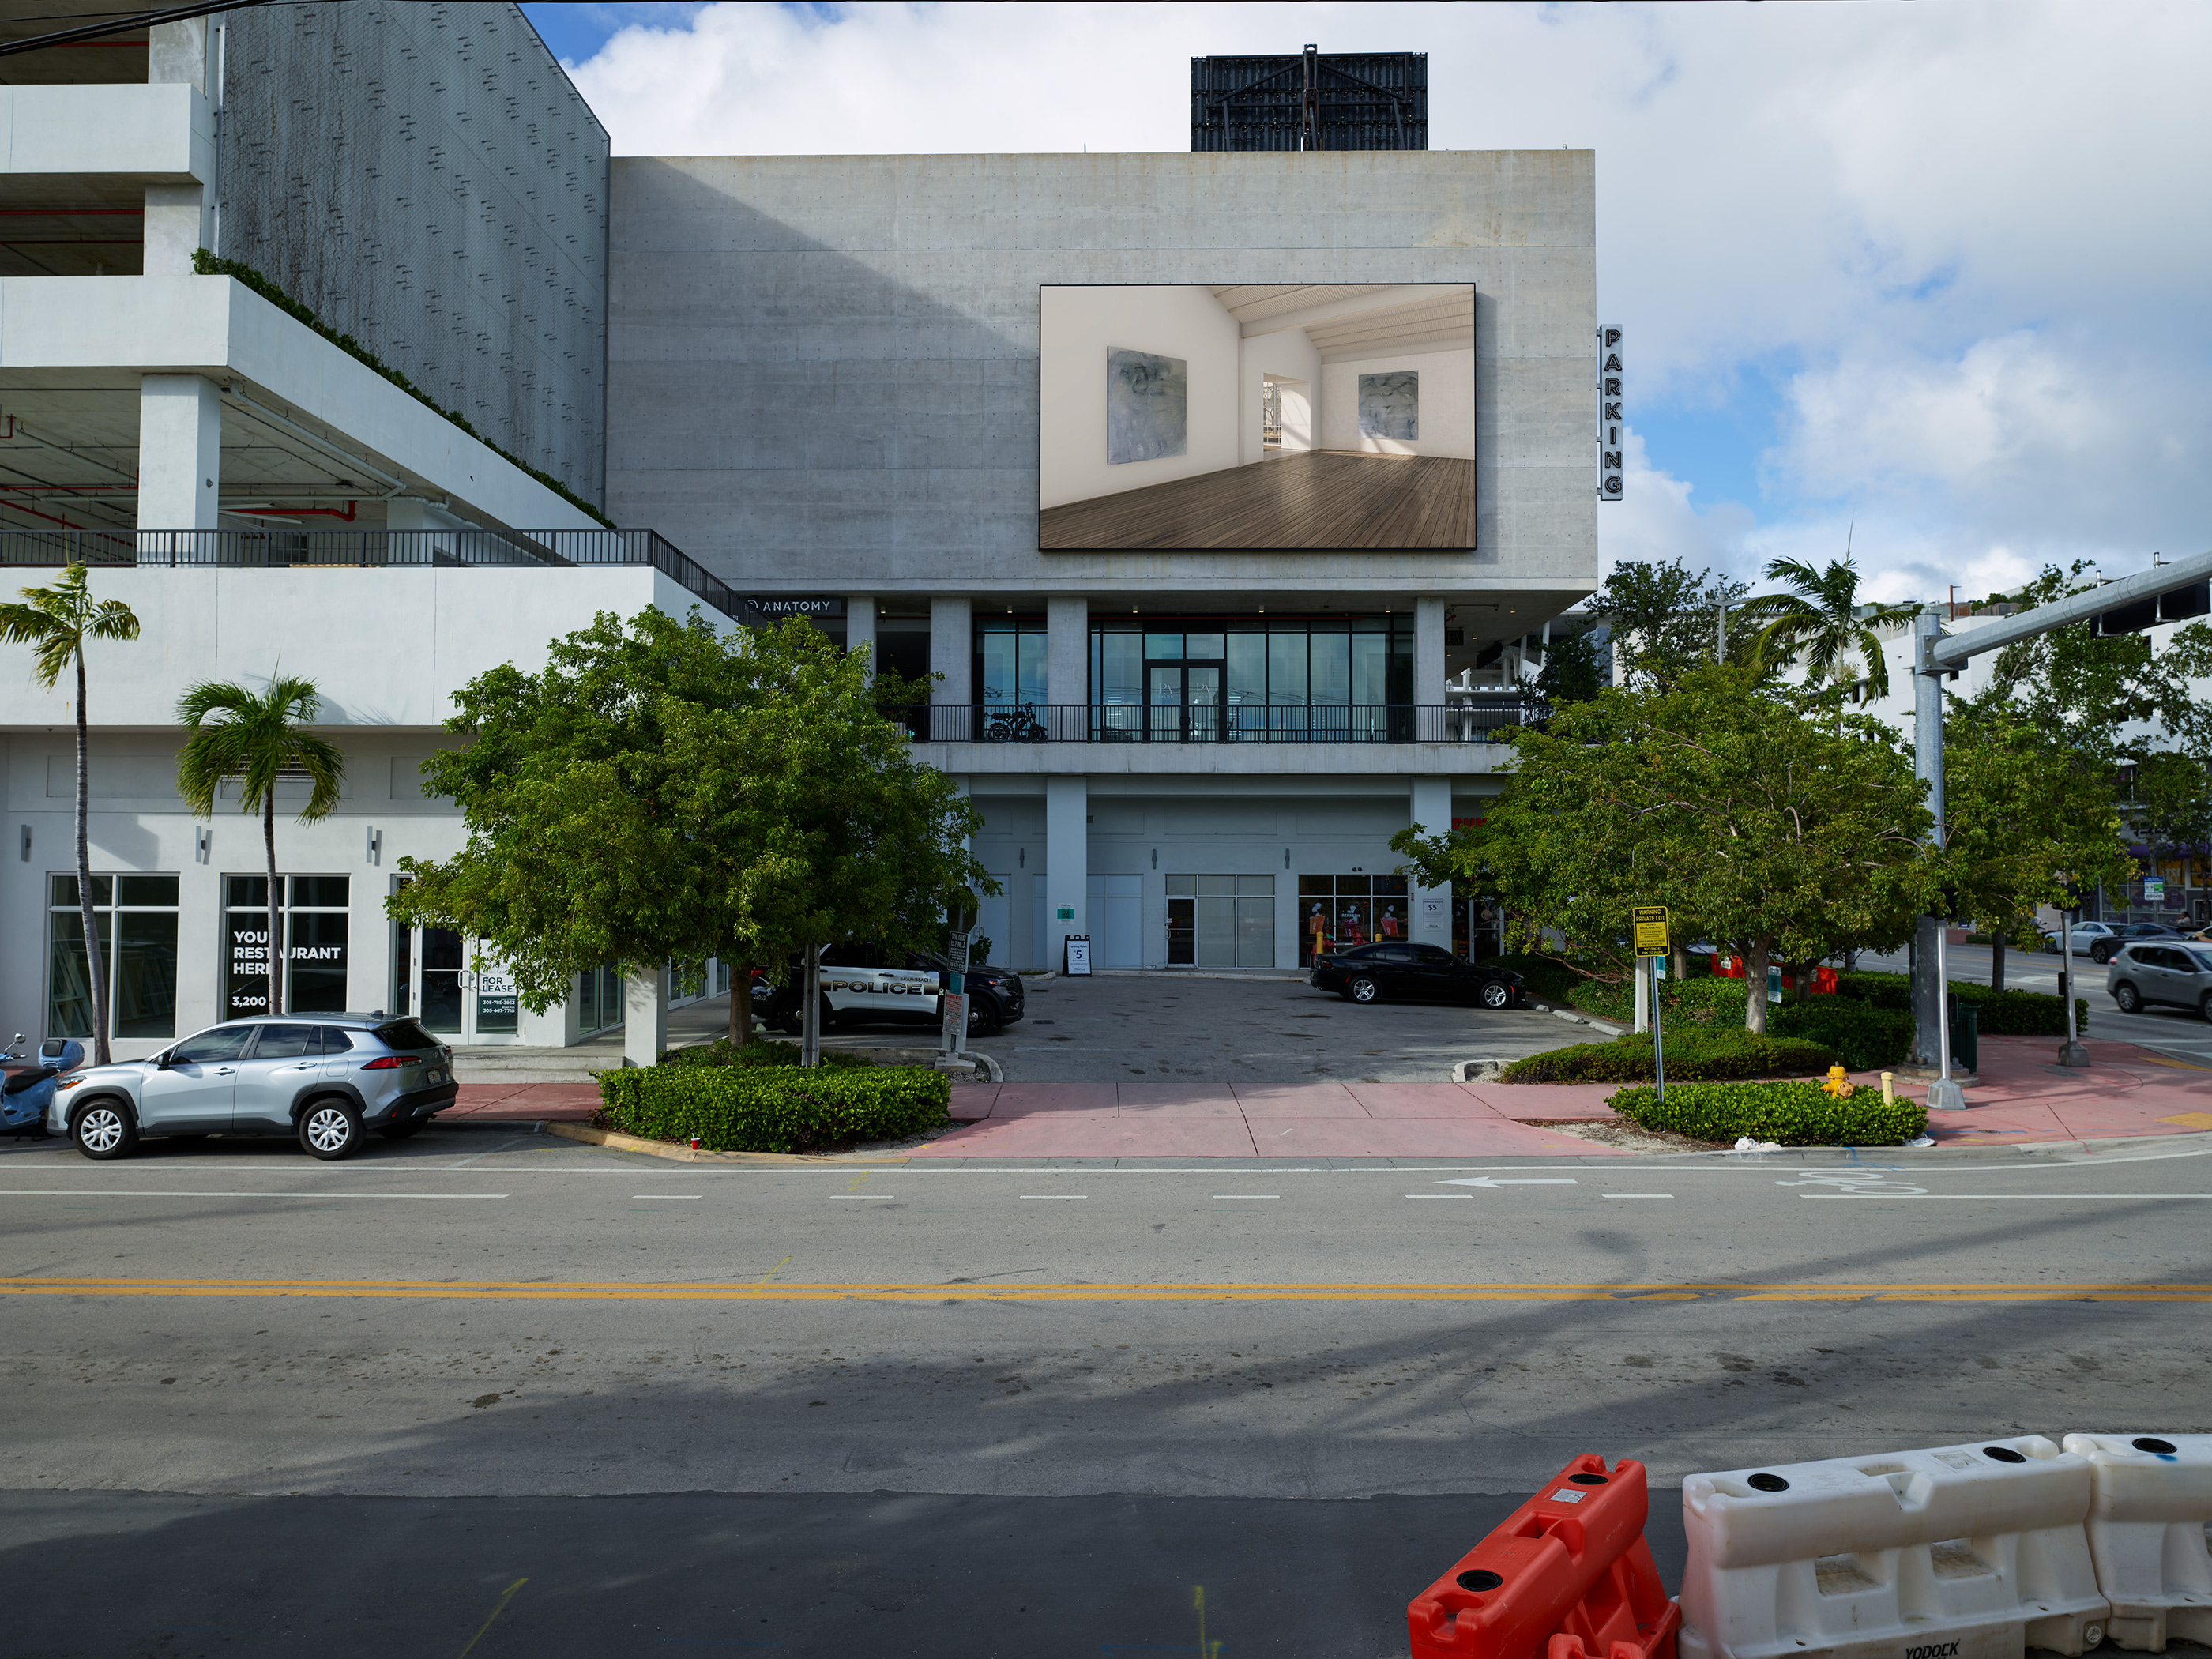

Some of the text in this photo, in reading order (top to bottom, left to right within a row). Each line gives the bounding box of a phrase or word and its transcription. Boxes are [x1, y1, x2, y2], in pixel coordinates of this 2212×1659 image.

[1604, 329, 1622, 493] PARKING
[762, 601, 830, 611] ANATOMY
[1158, 683, 1172, 694] PA
[1196, 683, 1210, 694] PA
[1452, 817, 1488, 830] DUN
[233, 931, 268, 944] YOU
[233, 947, 341, 959] RESTURANT
[832, 980, 924, 995] POLICE
[231, 996, 267, 1008] 3,200
[1905, 1642, 1960, 1659] YODOCK
